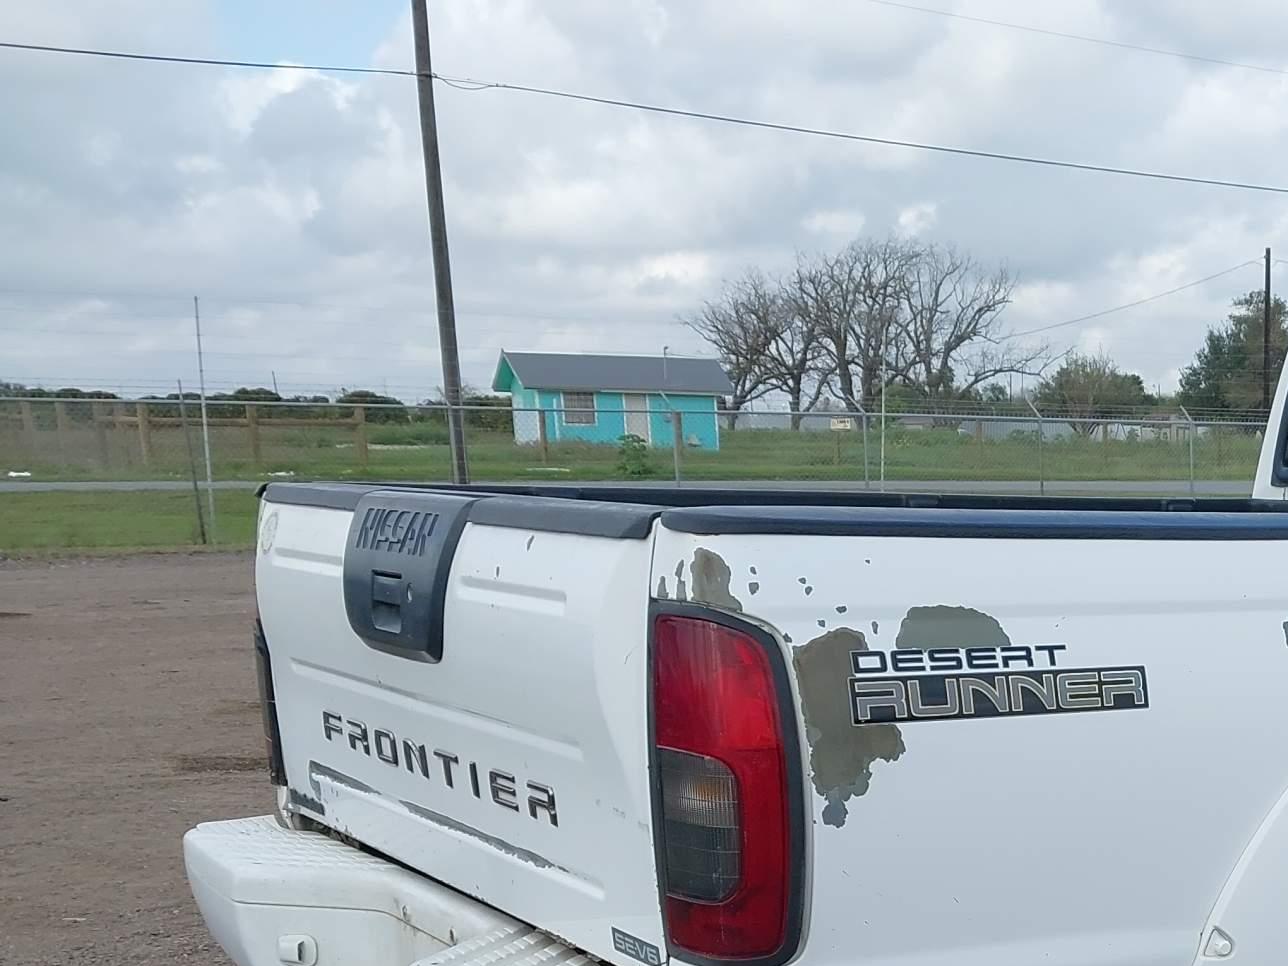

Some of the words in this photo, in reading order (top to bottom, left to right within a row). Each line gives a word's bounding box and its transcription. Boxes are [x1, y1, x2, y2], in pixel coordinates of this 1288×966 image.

[355, 507, 440, 557] NISSAN
[850, 645, 1067, 674] DESERT
[852, 668, 1147, 723] RUNNER
[322, 710, 560, 828] FRONTIER
